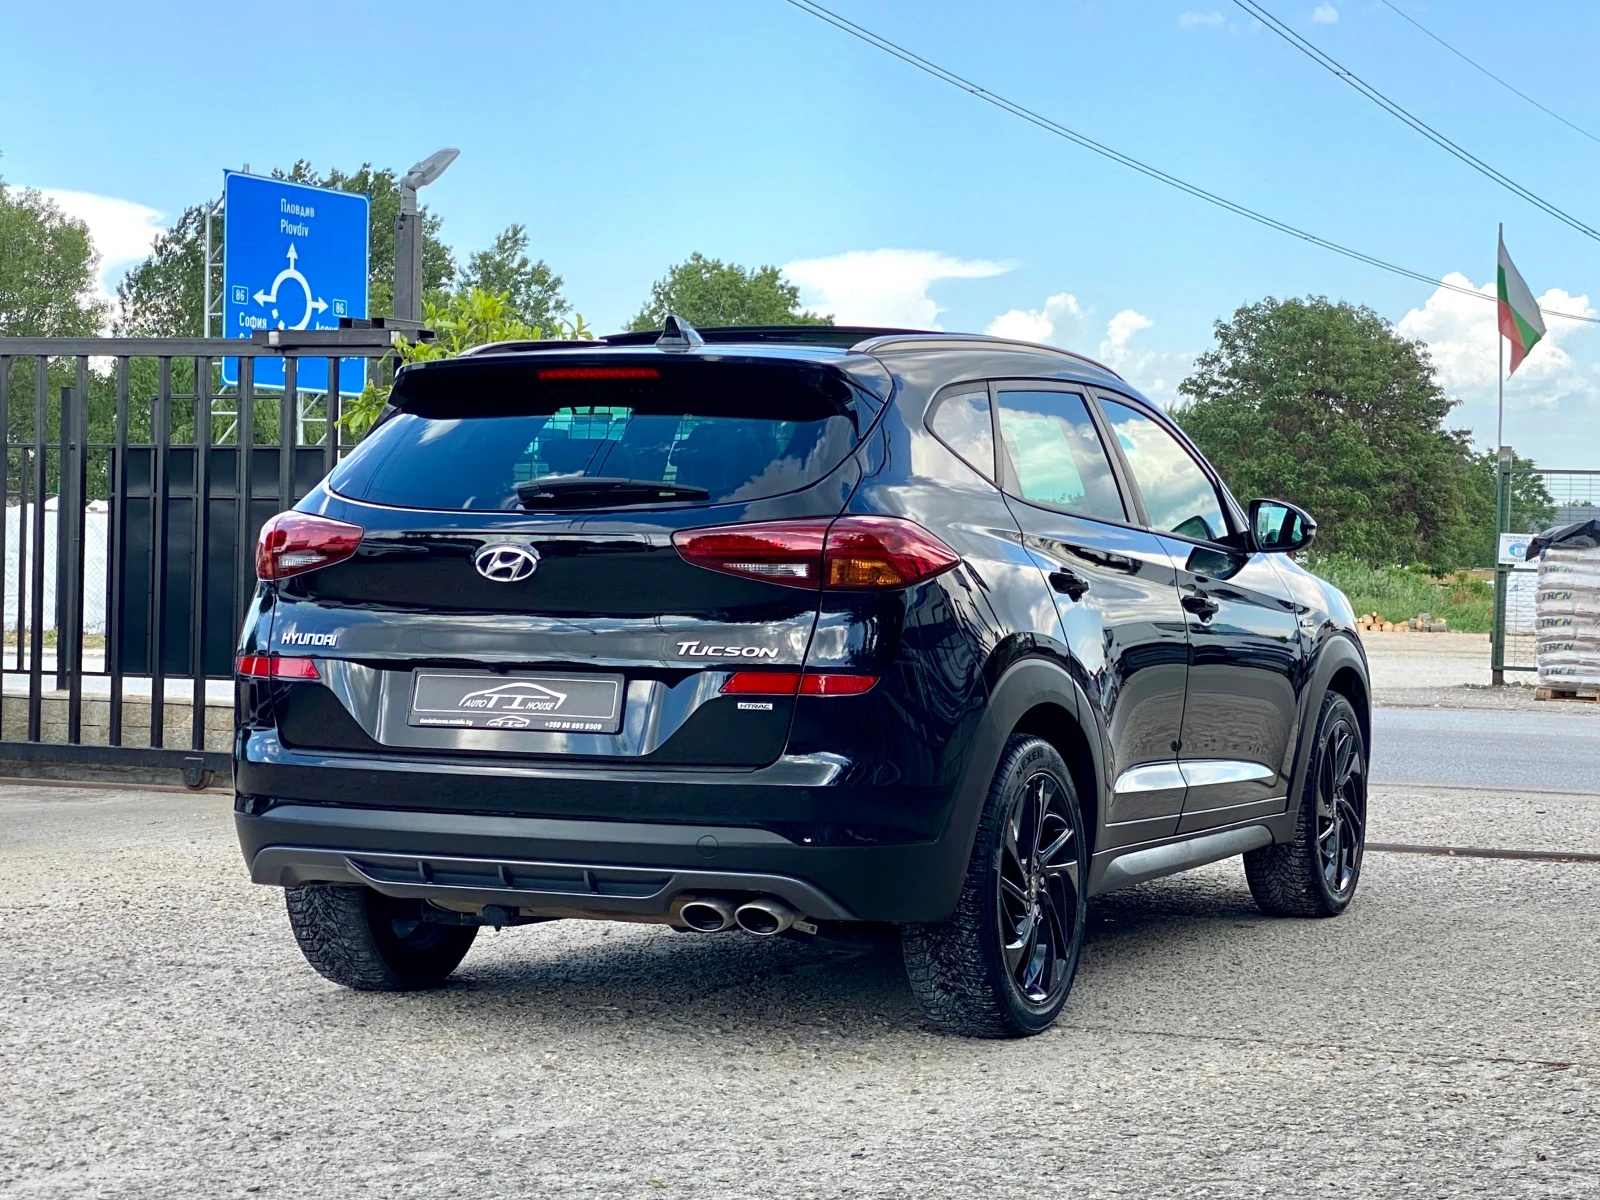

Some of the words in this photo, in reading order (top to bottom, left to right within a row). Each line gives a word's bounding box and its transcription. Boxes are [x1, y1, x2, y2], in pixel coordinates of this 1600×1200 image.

[280, 198, 315, 218] Пловдив
[280, 218, 309, 237] Plovdiv
[235, 289, 245, 301] 86
[335, 302, 345, 314] 86
[239, 312, 267, 329] София
[281, 632, 338, 647] HYUNDAI
[676, 641, 779, 658] TUCSON
[463, 699, 488, 708] AUTO
[525, 701, 556, 711] HOUSE
[739, 702, 771, 710] HTRAC
